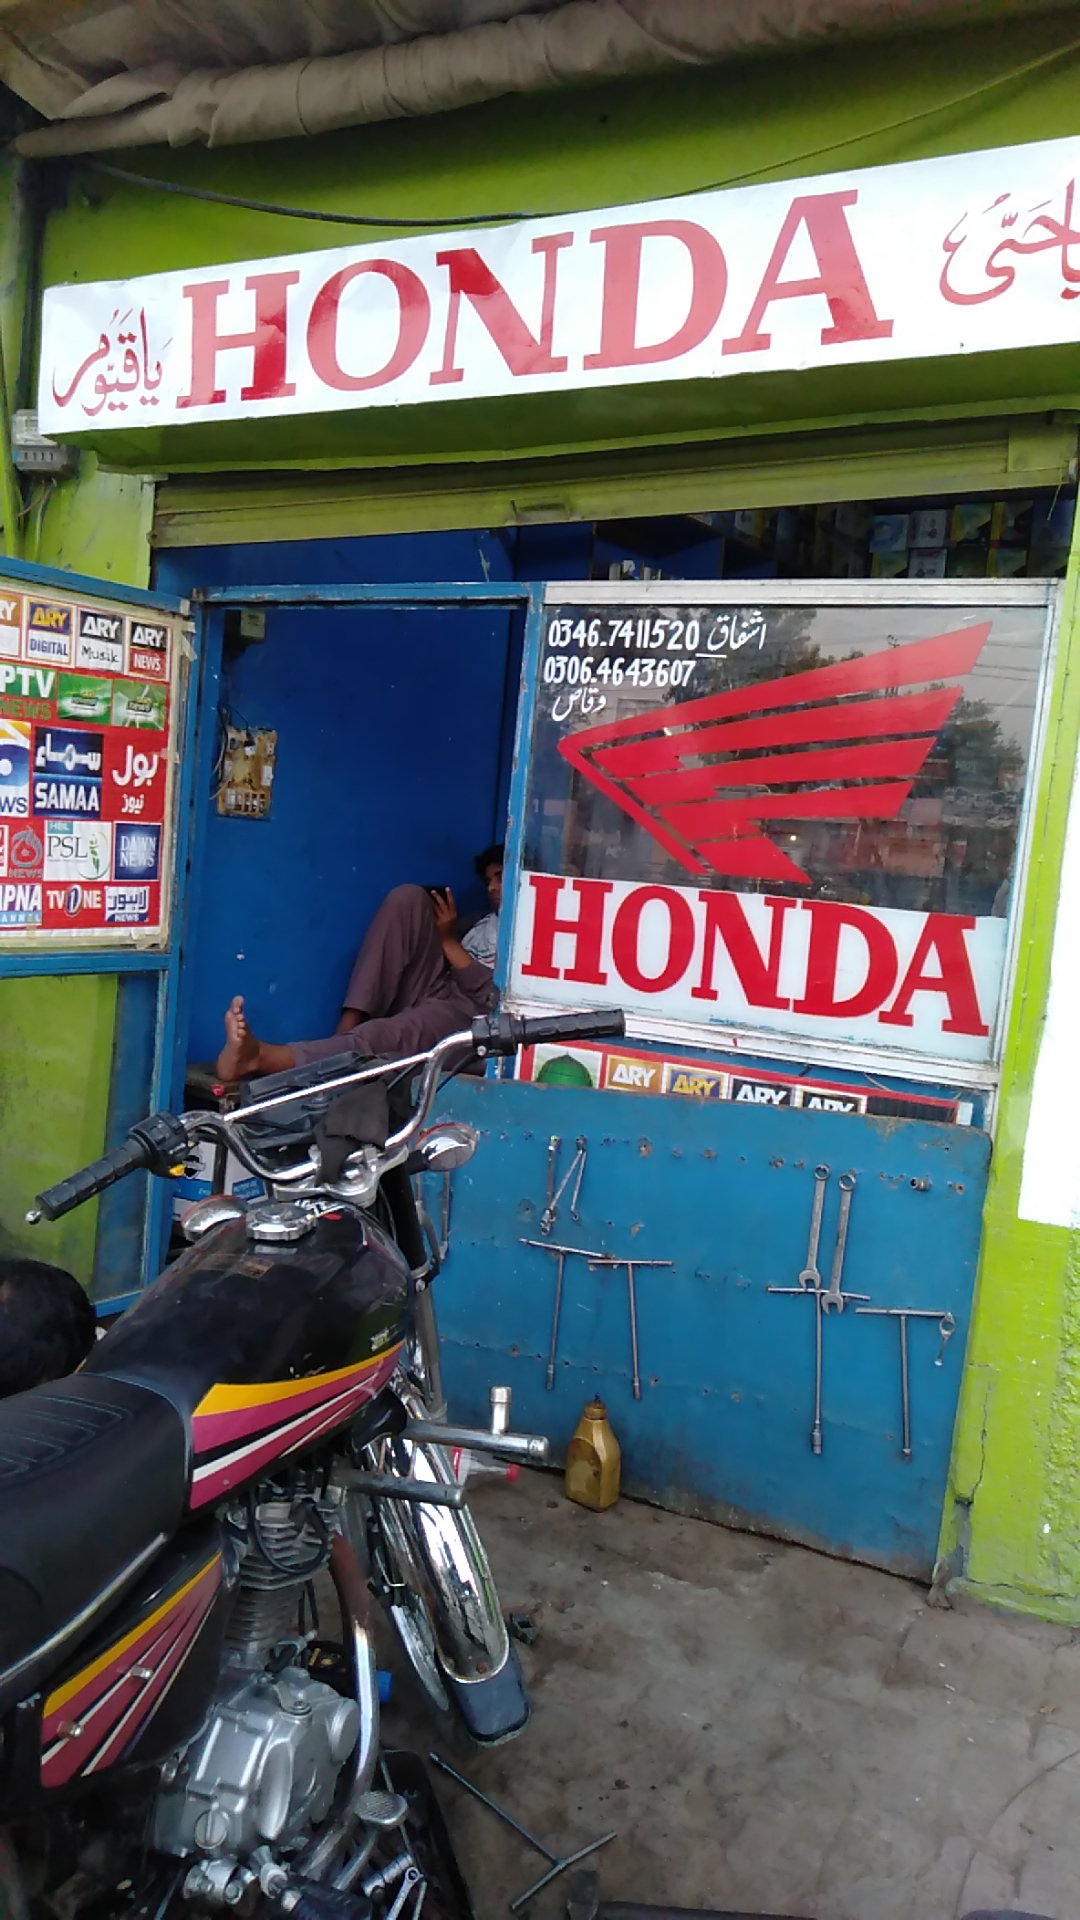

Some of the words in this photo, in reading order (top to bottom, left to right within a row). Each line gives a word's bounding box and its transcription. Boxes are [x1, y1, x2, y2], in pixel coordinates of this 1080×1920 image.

[176, 189, 894, 409] HONDA
[0, 600, 17, 621] RY
[32, 607, 67, 628] ARY
[82, 616, 120, 639] ARY
[132, 626, 164, 647] ARY
[30, 638, 68, 656] DIGITAL
[133, 653, 161, 671] NEWS
[0, 664, 56, 698] PTV
[34, 782, 100, 811] SAMAA
[47, 835, 88, 858] PSL
[120, 835, 157, 851] DAWN
[119, 851, 155, 867] NEWS
[0, 885, 42, 911] PNA
[521, 875, 989, 1036] HONDA
[612, 1063, 656, 1088] ARY
[672, 1074, 717, 1096] ARY
[736, 1084, 787, 1104] ARY
